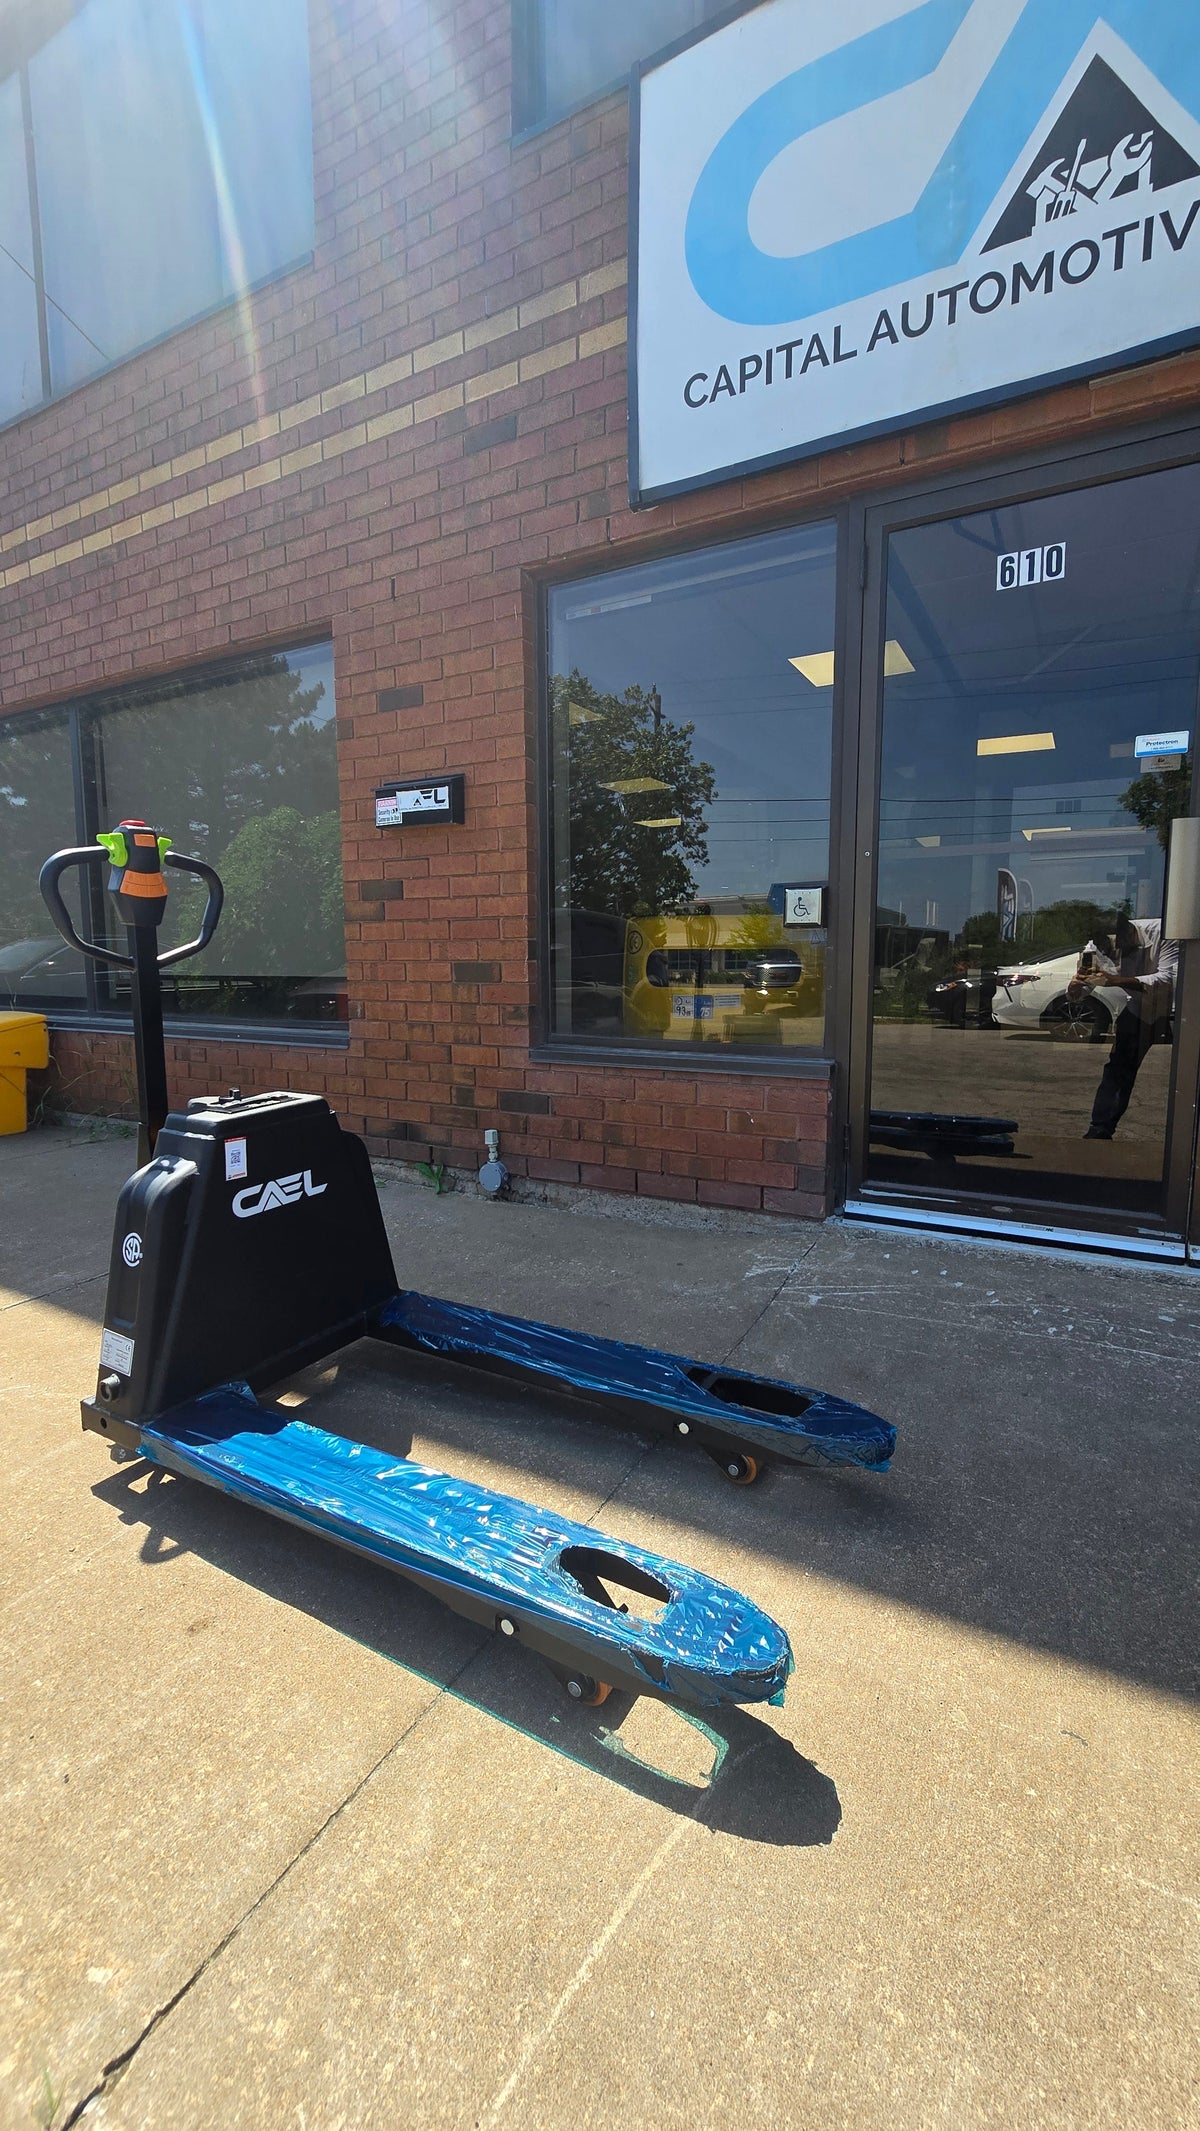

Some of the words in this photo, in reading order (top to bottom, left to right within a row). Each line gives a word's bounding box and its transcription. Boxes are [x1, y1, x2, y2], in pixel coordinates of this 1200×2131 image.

[683, 325, 858, 409] CAPITAL
[866, 198, 1200, 353] AUTOMOTIV
[1000, 545, 1063, 588] 610
[232, 1169, 328, 1218] CAEL
